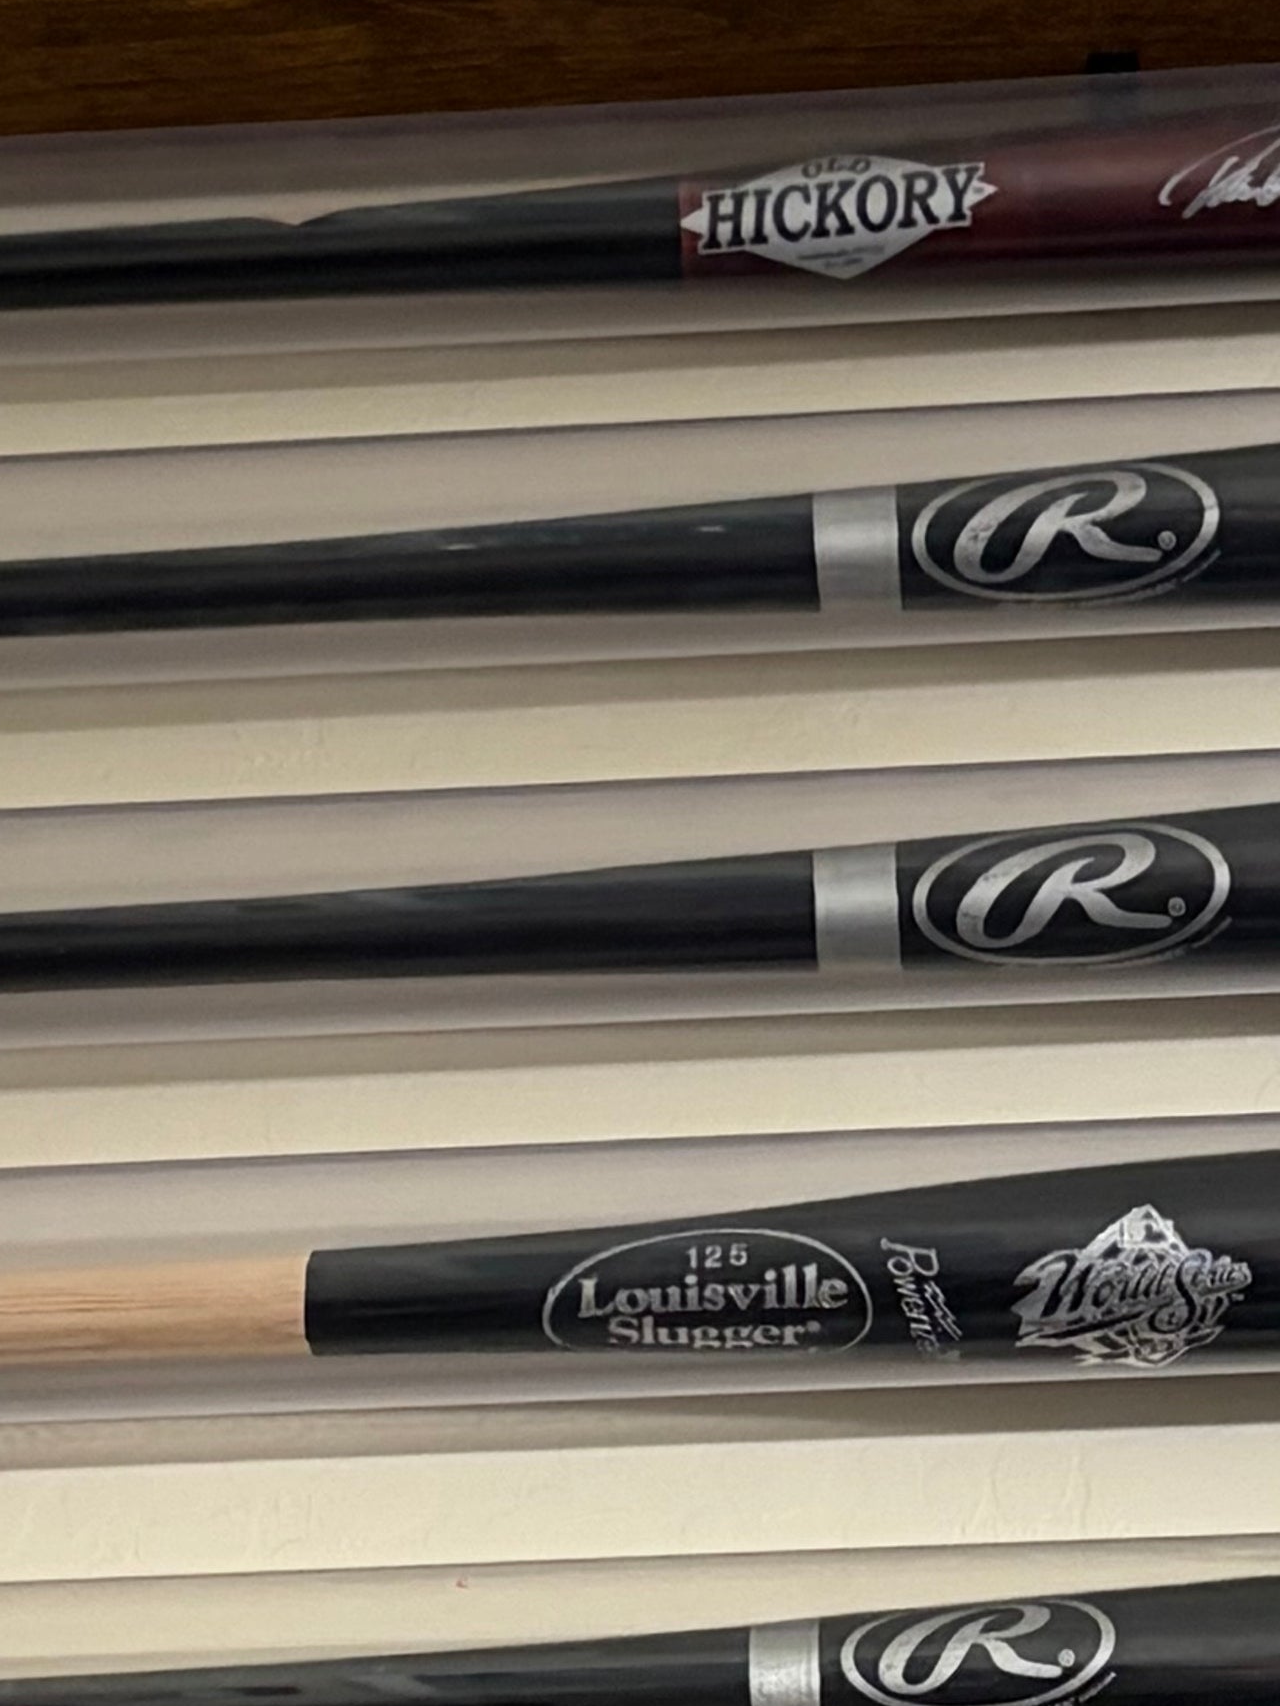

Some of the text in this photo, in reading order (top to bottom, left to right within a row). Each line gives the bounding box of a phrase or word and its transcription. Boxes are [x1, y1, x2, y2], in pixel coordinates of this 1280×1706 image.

[801, 157, 871, 179] OLD
[702, 166, 982, 251] HICKORY
[685, 1242, 748, 1270] 125
[577, 1262, 850, 1319] Louisville
[607, 1316, 806, 1350] Slugger
